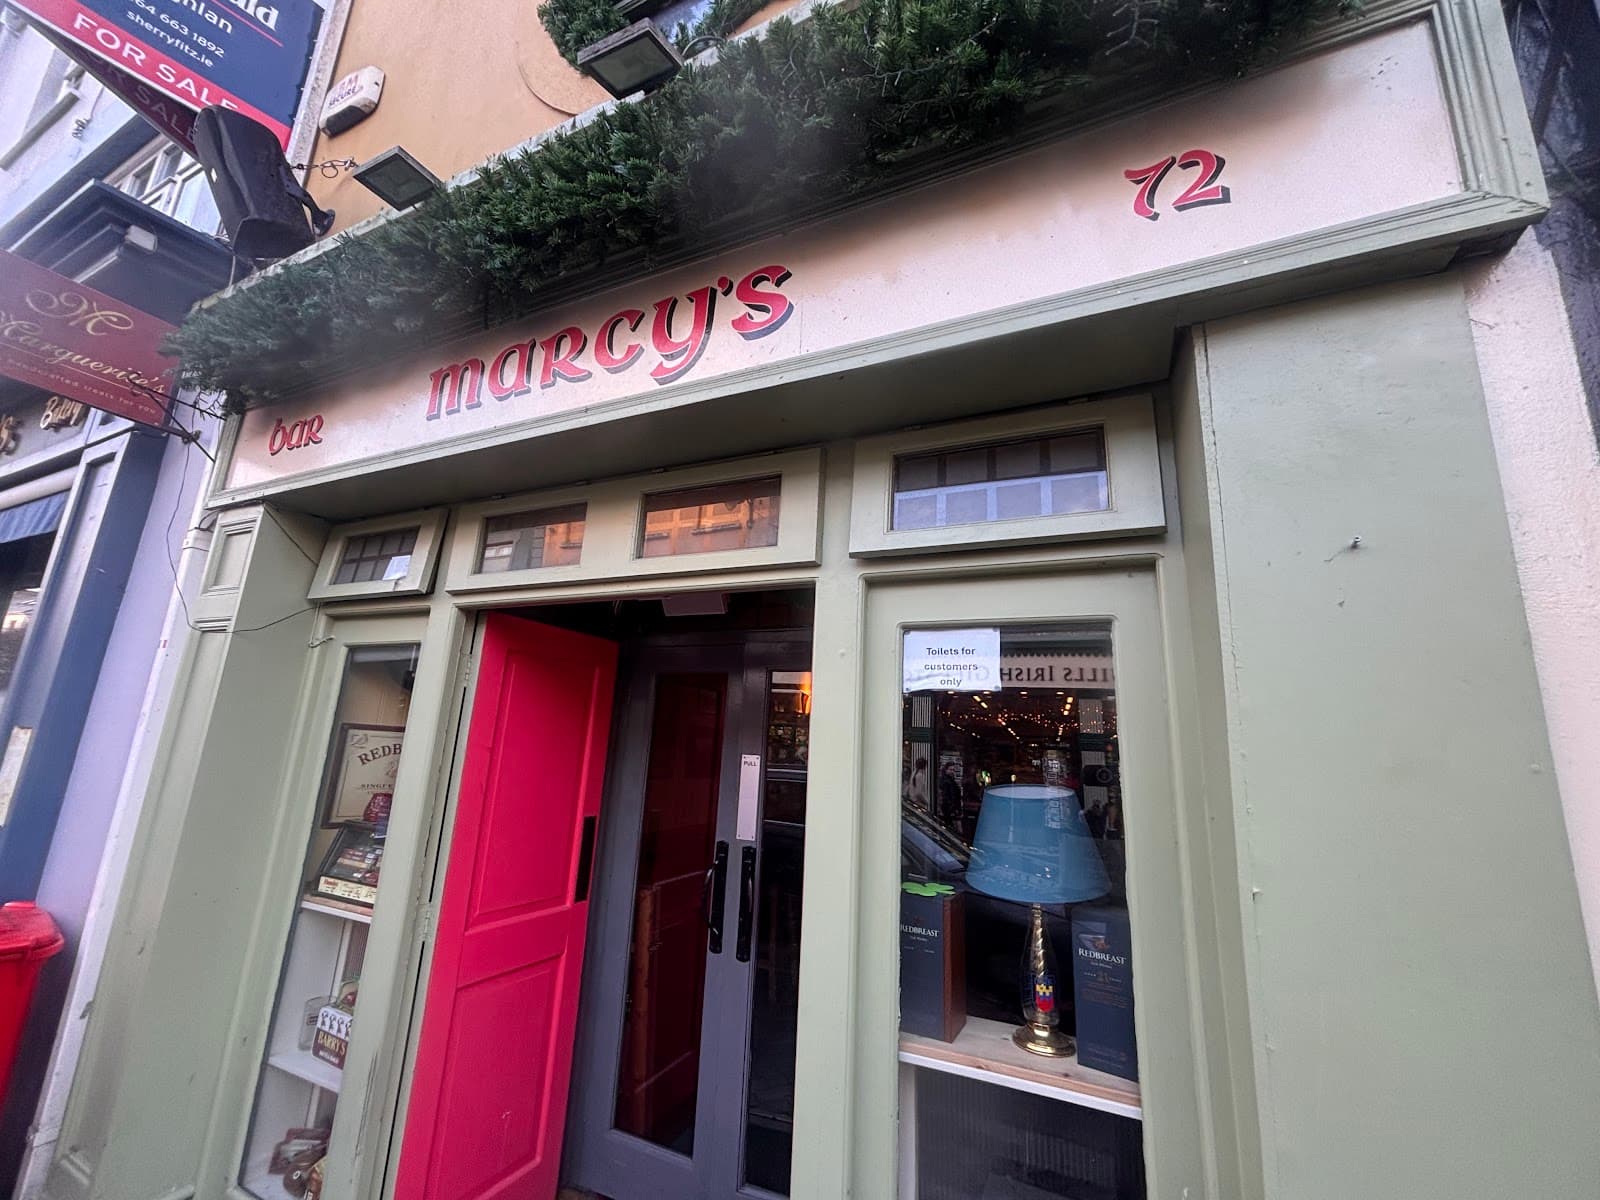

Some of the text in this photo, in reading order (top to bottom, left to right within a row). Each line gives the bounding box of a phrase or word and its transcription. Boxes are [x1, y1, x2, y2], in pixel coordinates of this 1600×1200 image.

[73, 12, 147, 67] FOR
[126, 11, 214, 68] sherryfitz.ie
[159, 13, 189, 36] 663
[192, 32, 225, 58] 1892
[1123, 149, 1231, 222] 72
[924, 662, 978, 671] customers
[926, 646, 976, 656] Toilets for
[940, 677, 962, 687] only
[1078, 947, 1126, 964] REDBREAST
